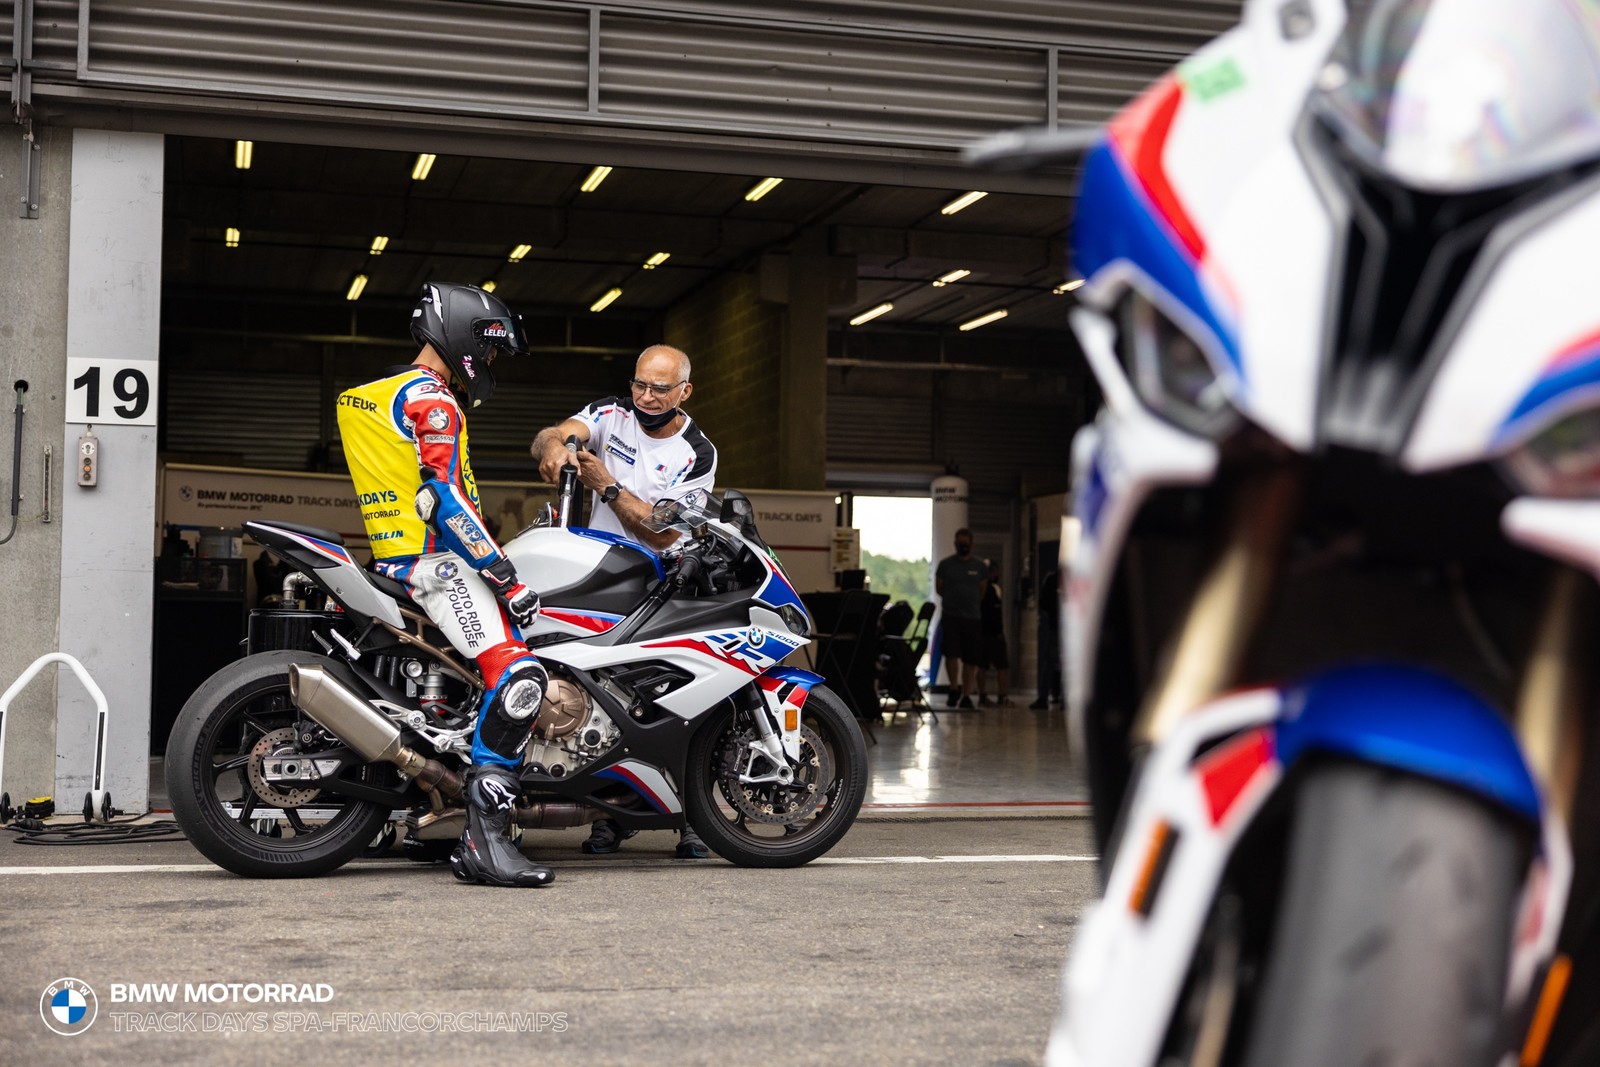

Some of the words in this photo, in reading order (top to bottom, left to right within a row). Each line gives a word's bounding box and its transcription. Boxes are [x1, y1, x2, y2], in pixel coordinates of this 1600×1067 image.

[483, 328, 507, 337] LELEU
[73, 366, 149, 419] 19
[337, 395, 377, 413] CTEUR
[197, 489, 227, 501] BMW
[230, 491, 294, 506] MOTORRAD
[297, 495, 333, 507] TRACK
[757, 511, 794, 522] TRACK
[795, 513, 823, 523] DAYS
[446, 587, 479, 649] TOULOUSE
[453, 578, 473, 610] MOTO
[467, 611, 486, 640] RIDE
[766, 630, 800, 647] S1000
